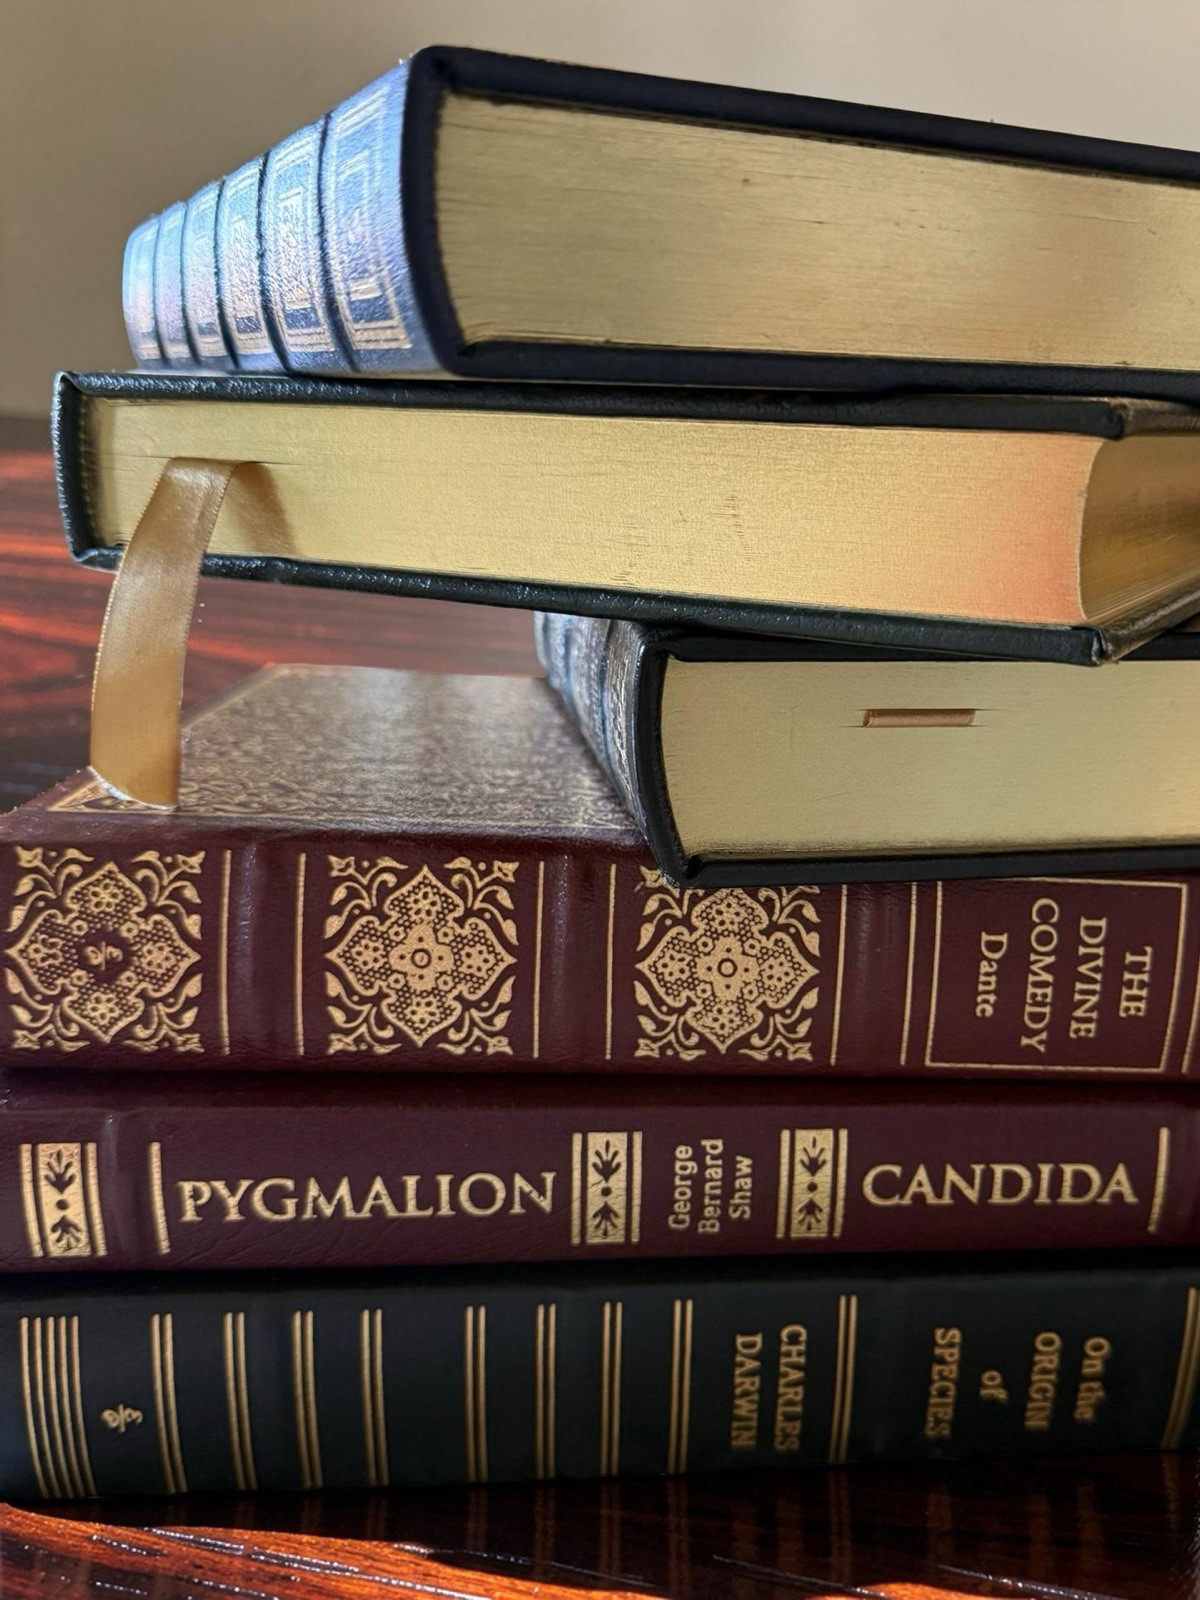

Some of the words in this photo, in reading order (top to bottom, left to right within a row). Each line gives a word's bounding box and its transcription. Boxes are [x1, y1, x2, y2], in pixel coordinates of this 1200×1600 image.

[975, 932, 1009, 1018] Dante
[1020, 898, 1060, 1053] COMEDY
[1069, 917, 1107, 1040] DIVINE
[1119, 946, 1153, 1018] THE
[177, 1172, 557, 1222] PYGMALION
[667, 1144, 698, 1229] George
[697, 1138, 724, 1234] Bernard
[728, 1155, 753, 1219] Shaw
[862, 1163, 1139, 1206] CANDIDA
[731, 1332, 763, 1450] DARWIN
[774, 1324, 808, 1451] CHARLES
[925, 1327, 962, 1438] SPECIES
[979, 1369, 1008, 1401] of
[1024, 1331, 1062, 1430] ORIGIN
[1081, 1336, 1111, 1376] On
[1073, 1381, 1106, 1422] the
